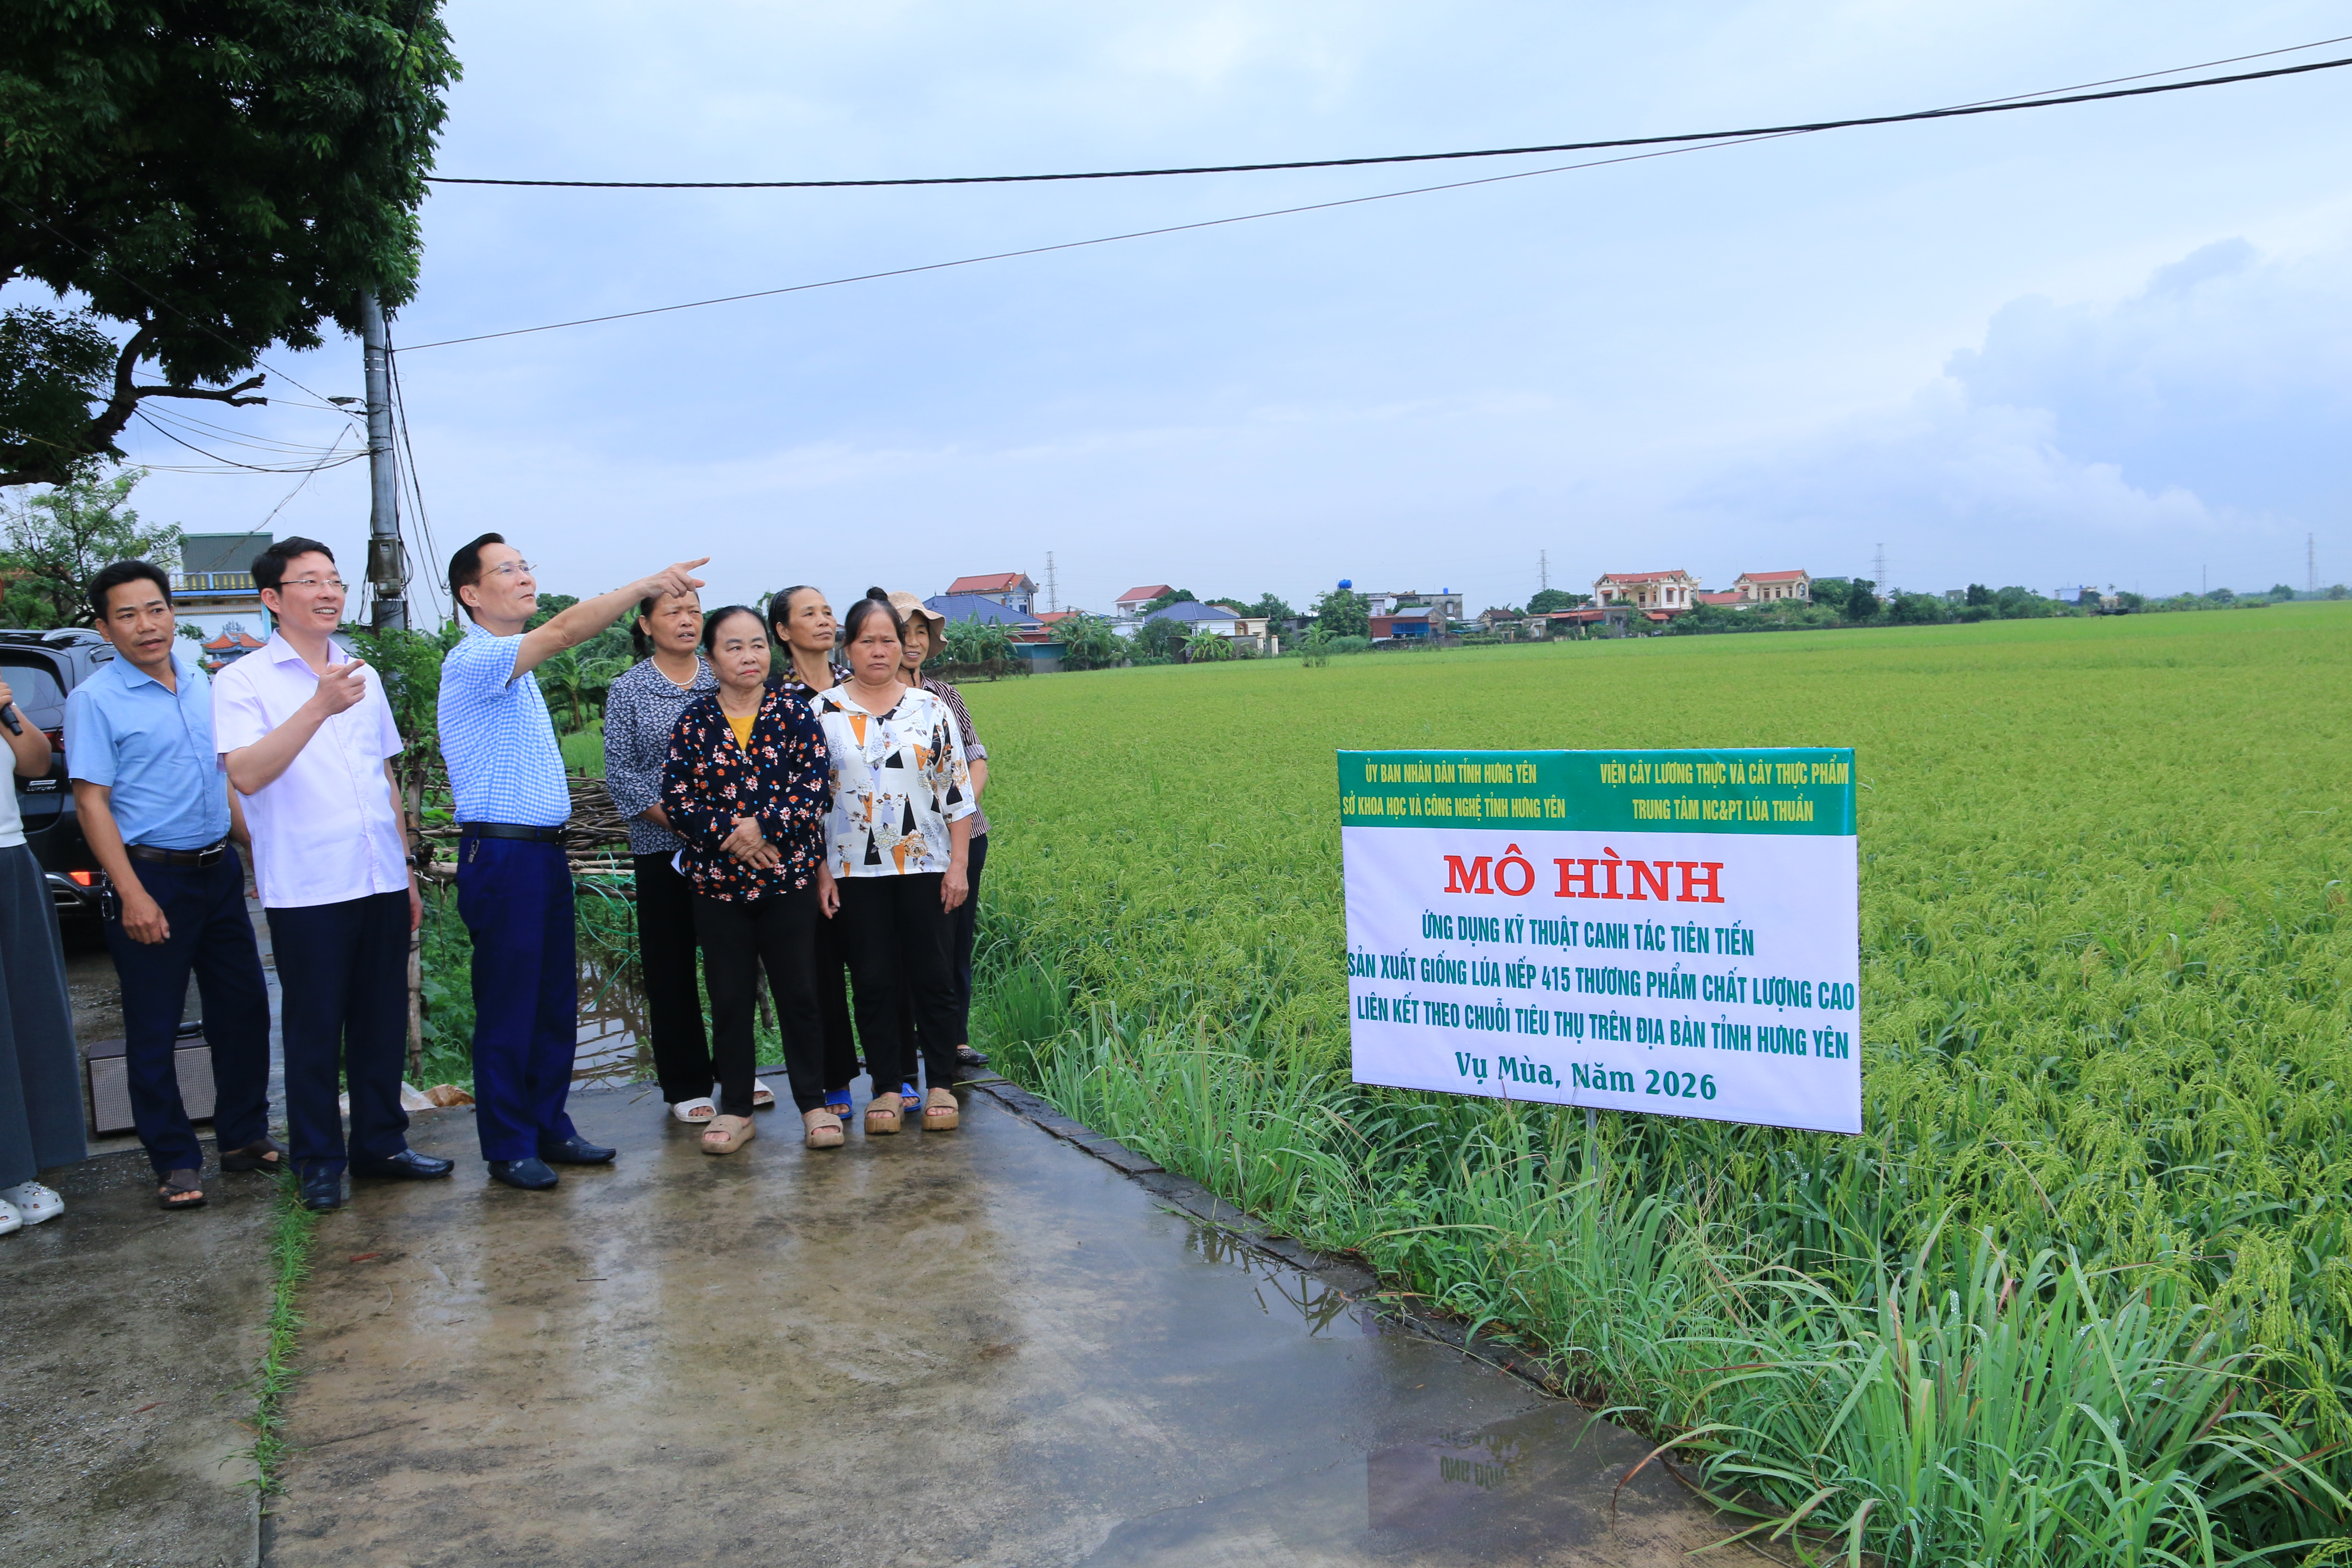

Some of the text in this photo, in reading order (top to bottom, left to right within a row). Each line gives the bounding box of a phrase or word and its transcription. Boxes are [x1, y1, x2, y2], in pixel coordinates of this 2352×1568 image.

[1366, 758, 1536, 783] ỦY BAN NHÂN DÂN TỈNH HƯNG YÊN
[1601, 754, 1848, 788] VIỆN CÂY LƯƠNG THỰC VÀ CÂY THỰC PHẨM
[1343, 790, 1565, 821] SỞ KHOA HỌC VÀ CÔNG NGHỆ TỈNH HƯNG YÊN
[1633, 793, 1813, 821] TRUNG TÂM NC&PT LÚA THUẦN
[1444, 843, 1724, 903] MÔ HÌNH
[1423, 909, 1754, 956] ỨNG DỤNG KỸ THUẬT CANH TÁC TIÊN TIẾN
[1348, 945, 1854, 1012] SẢN XUẤT GIỐNG LÚA NẾP 415 THƯƠNG PHẨM CHẤT LƯỢNG CAO
[1357, 992, 1848, 1059] LIÊN KẾT THEO CHUỖI TIÊU THỤ TRÊN ĐỊA BÀN TỈNH HƯNG YÊN
[1455, 1052, 1716, 1099] Vụ Mùa, Năm 2026
